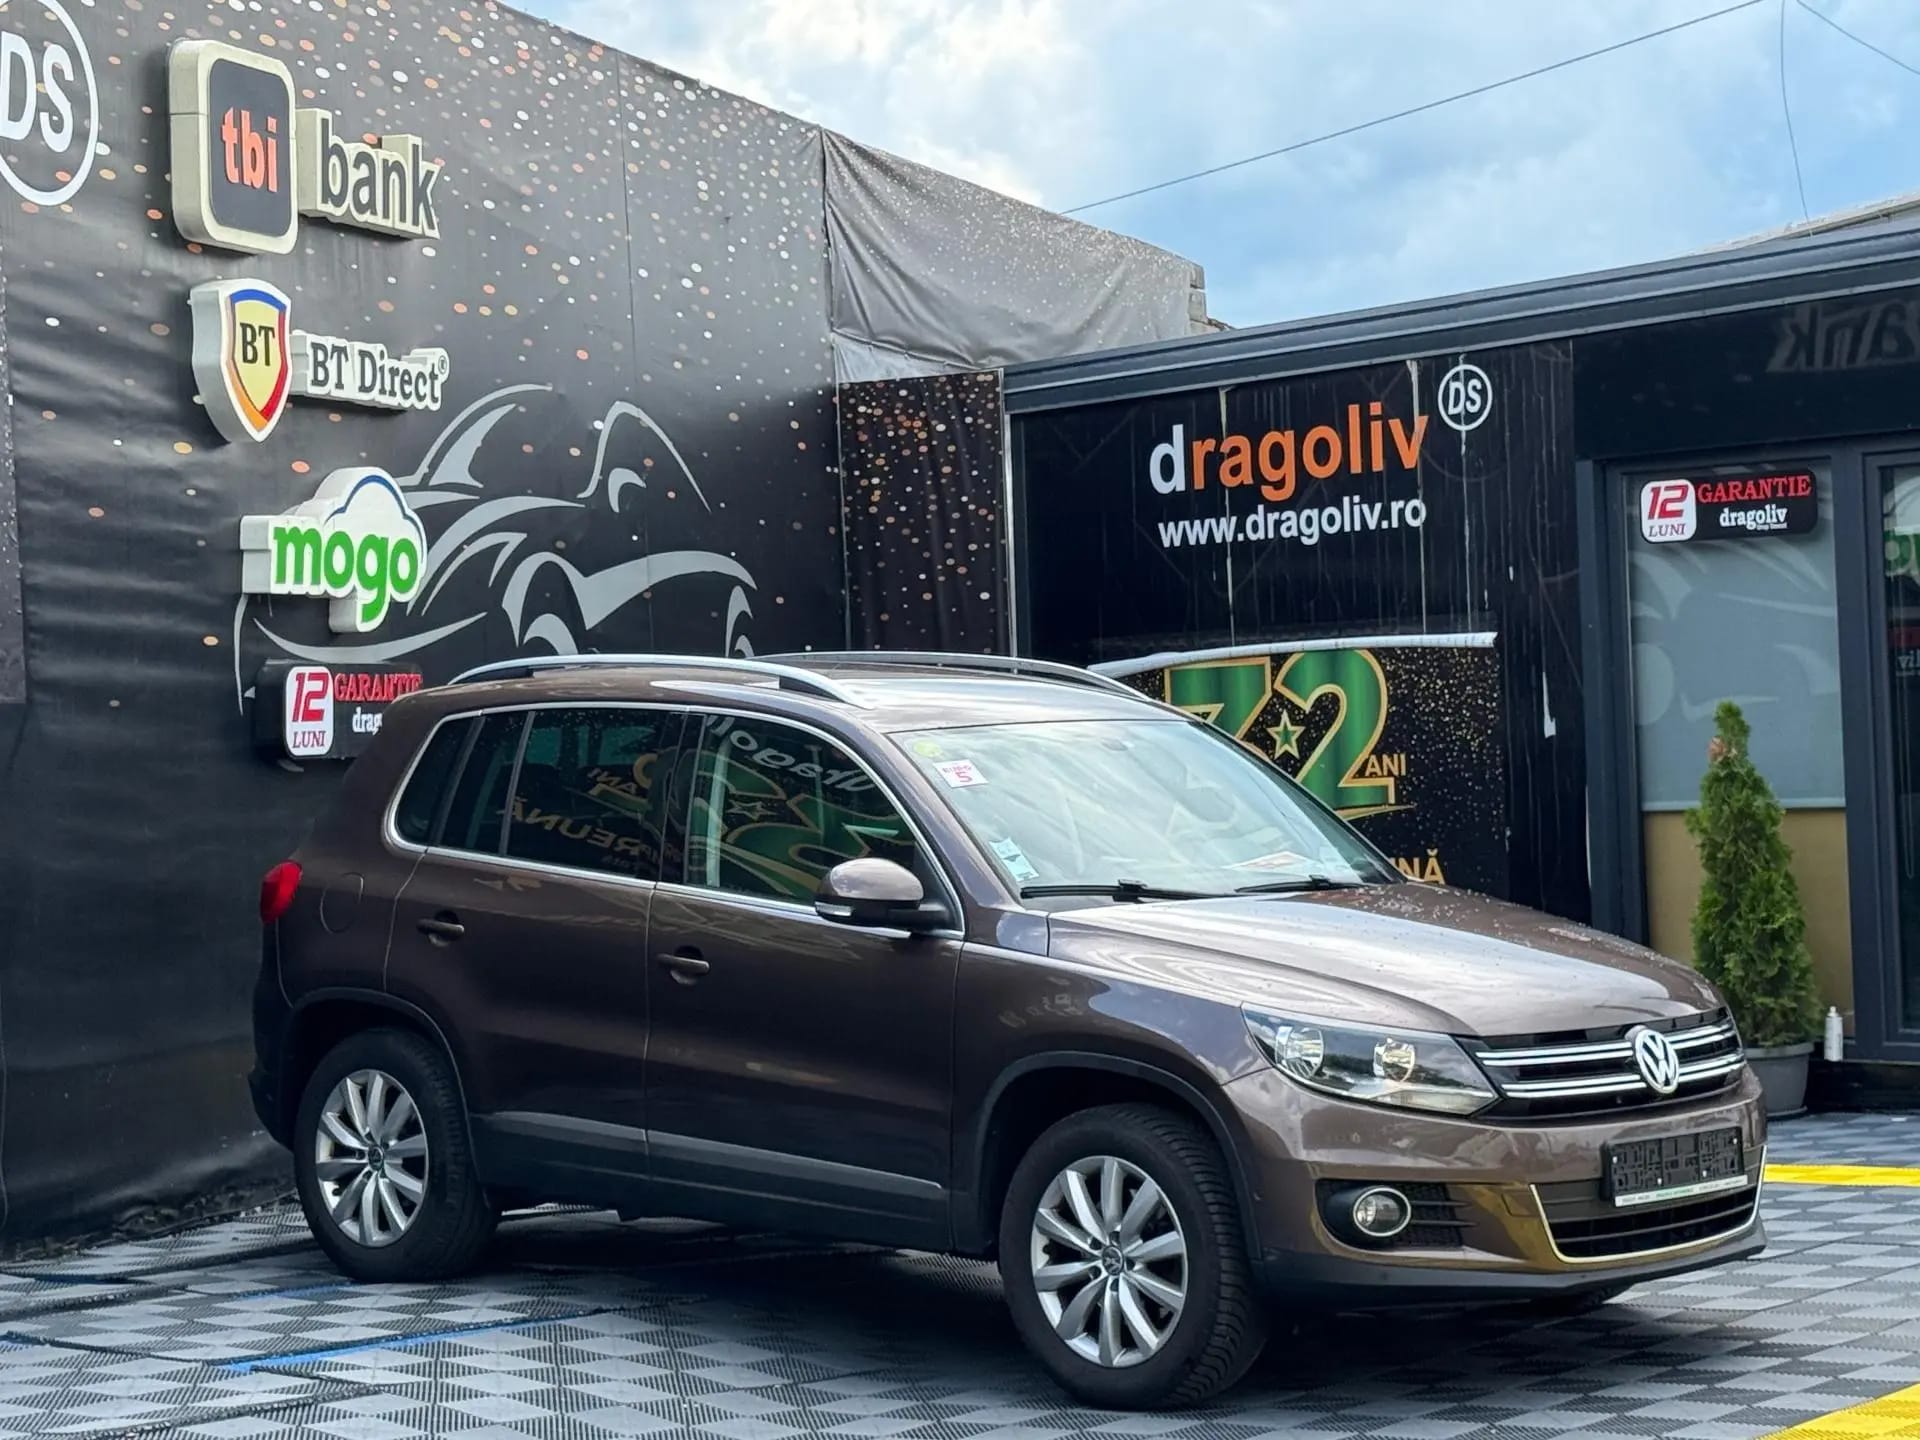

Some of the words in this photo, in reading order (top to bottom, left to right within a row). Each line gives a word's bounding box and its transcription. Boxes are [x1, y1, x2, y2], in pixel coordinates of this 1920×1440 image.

[0, 31, 75, 153] DS
[221, 107, 279, 193] tbi
[320, 118, 436, 232] bank
[239, 322, 276, 367] BT
[311, 342, 349, 390] BT
[1448, 377, 1483, 415] DS
[1149, 402, 1430, 502] dragoliv
[1648, 484, 1689, 521] 12
[1698, 475, 1812, 503] GARANTIE
[1158, 495, 1427, 549] www.dragoliv.ro
[1648, 523, 1686, 538] LUNI
[1719, 504, 1788, 530] dragoliv
[273, 525, 419, 624] mogo
[292, 672, 330, 723] 12
[292, 731, 326, 749] LUNI
[955, 771, 973, 783] 5
[1364, 754, 1406, 777] ANI
